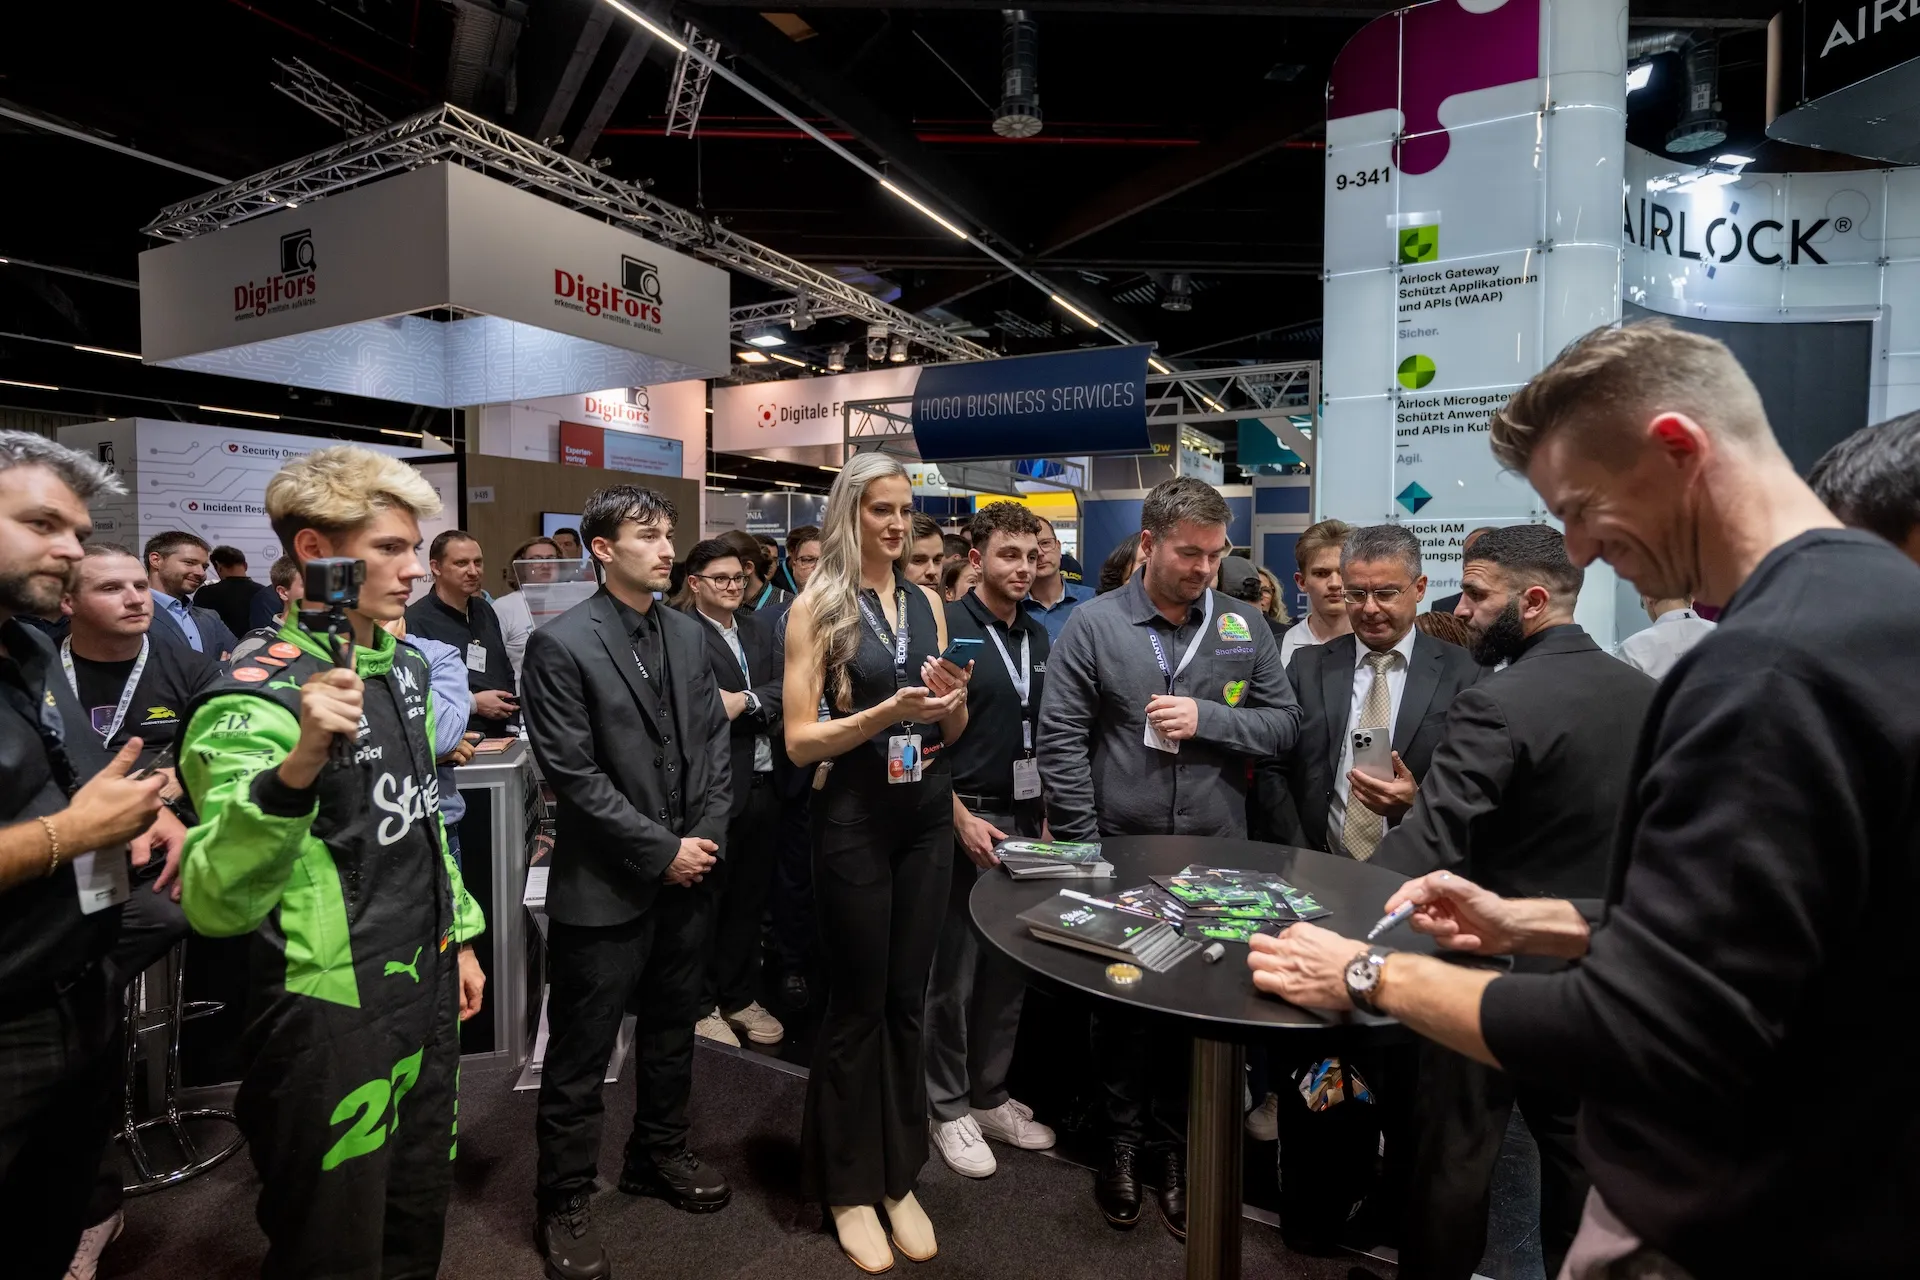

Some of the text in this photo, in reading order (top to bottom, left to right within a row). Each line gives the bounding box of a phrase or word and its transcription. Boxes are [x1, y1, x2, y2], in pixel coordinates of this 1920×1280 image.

[1336, 166, 1390, 190] 9-341
[1400, 265, 1500, 286] Airlock Gateway
[1399, 274, 1538, 299] Schützt Applikationen
[234, 274, 316, 317] DigiFors
[555, 268, 661, 324] DigiFors
[1399, 291, 1504, 312] und APIs (WAAP)
[1398, 328, 1440, 340] Sicher.
[920, 381, 1135, 421] HOGO BUSINESS SERVICES
[1397, 397, 1441, 410] Airlock
[585, 397, 649, 423] DigiFors
[781, 403, 828, 425] Digitale
[1397, 407, 1498, 423] Schützt Anwend
[1397, 422, 1490, 437] und APIs in Kub
[242, 445, 280, 459] Security
[1396, 454, 1423, 466] Agil.
[203, 502, 267, 515] Incident Resp
[1441, 523, 1464, 533] IAM
[1448, 537, 1464, 547] Au
[1420, 552, 1462, 562] rungsp
[1215, 645, 1254, 656] ShareGate
[211, 730, 250, 740] NETWORK
[322, 1043, 424, 1171] 27
